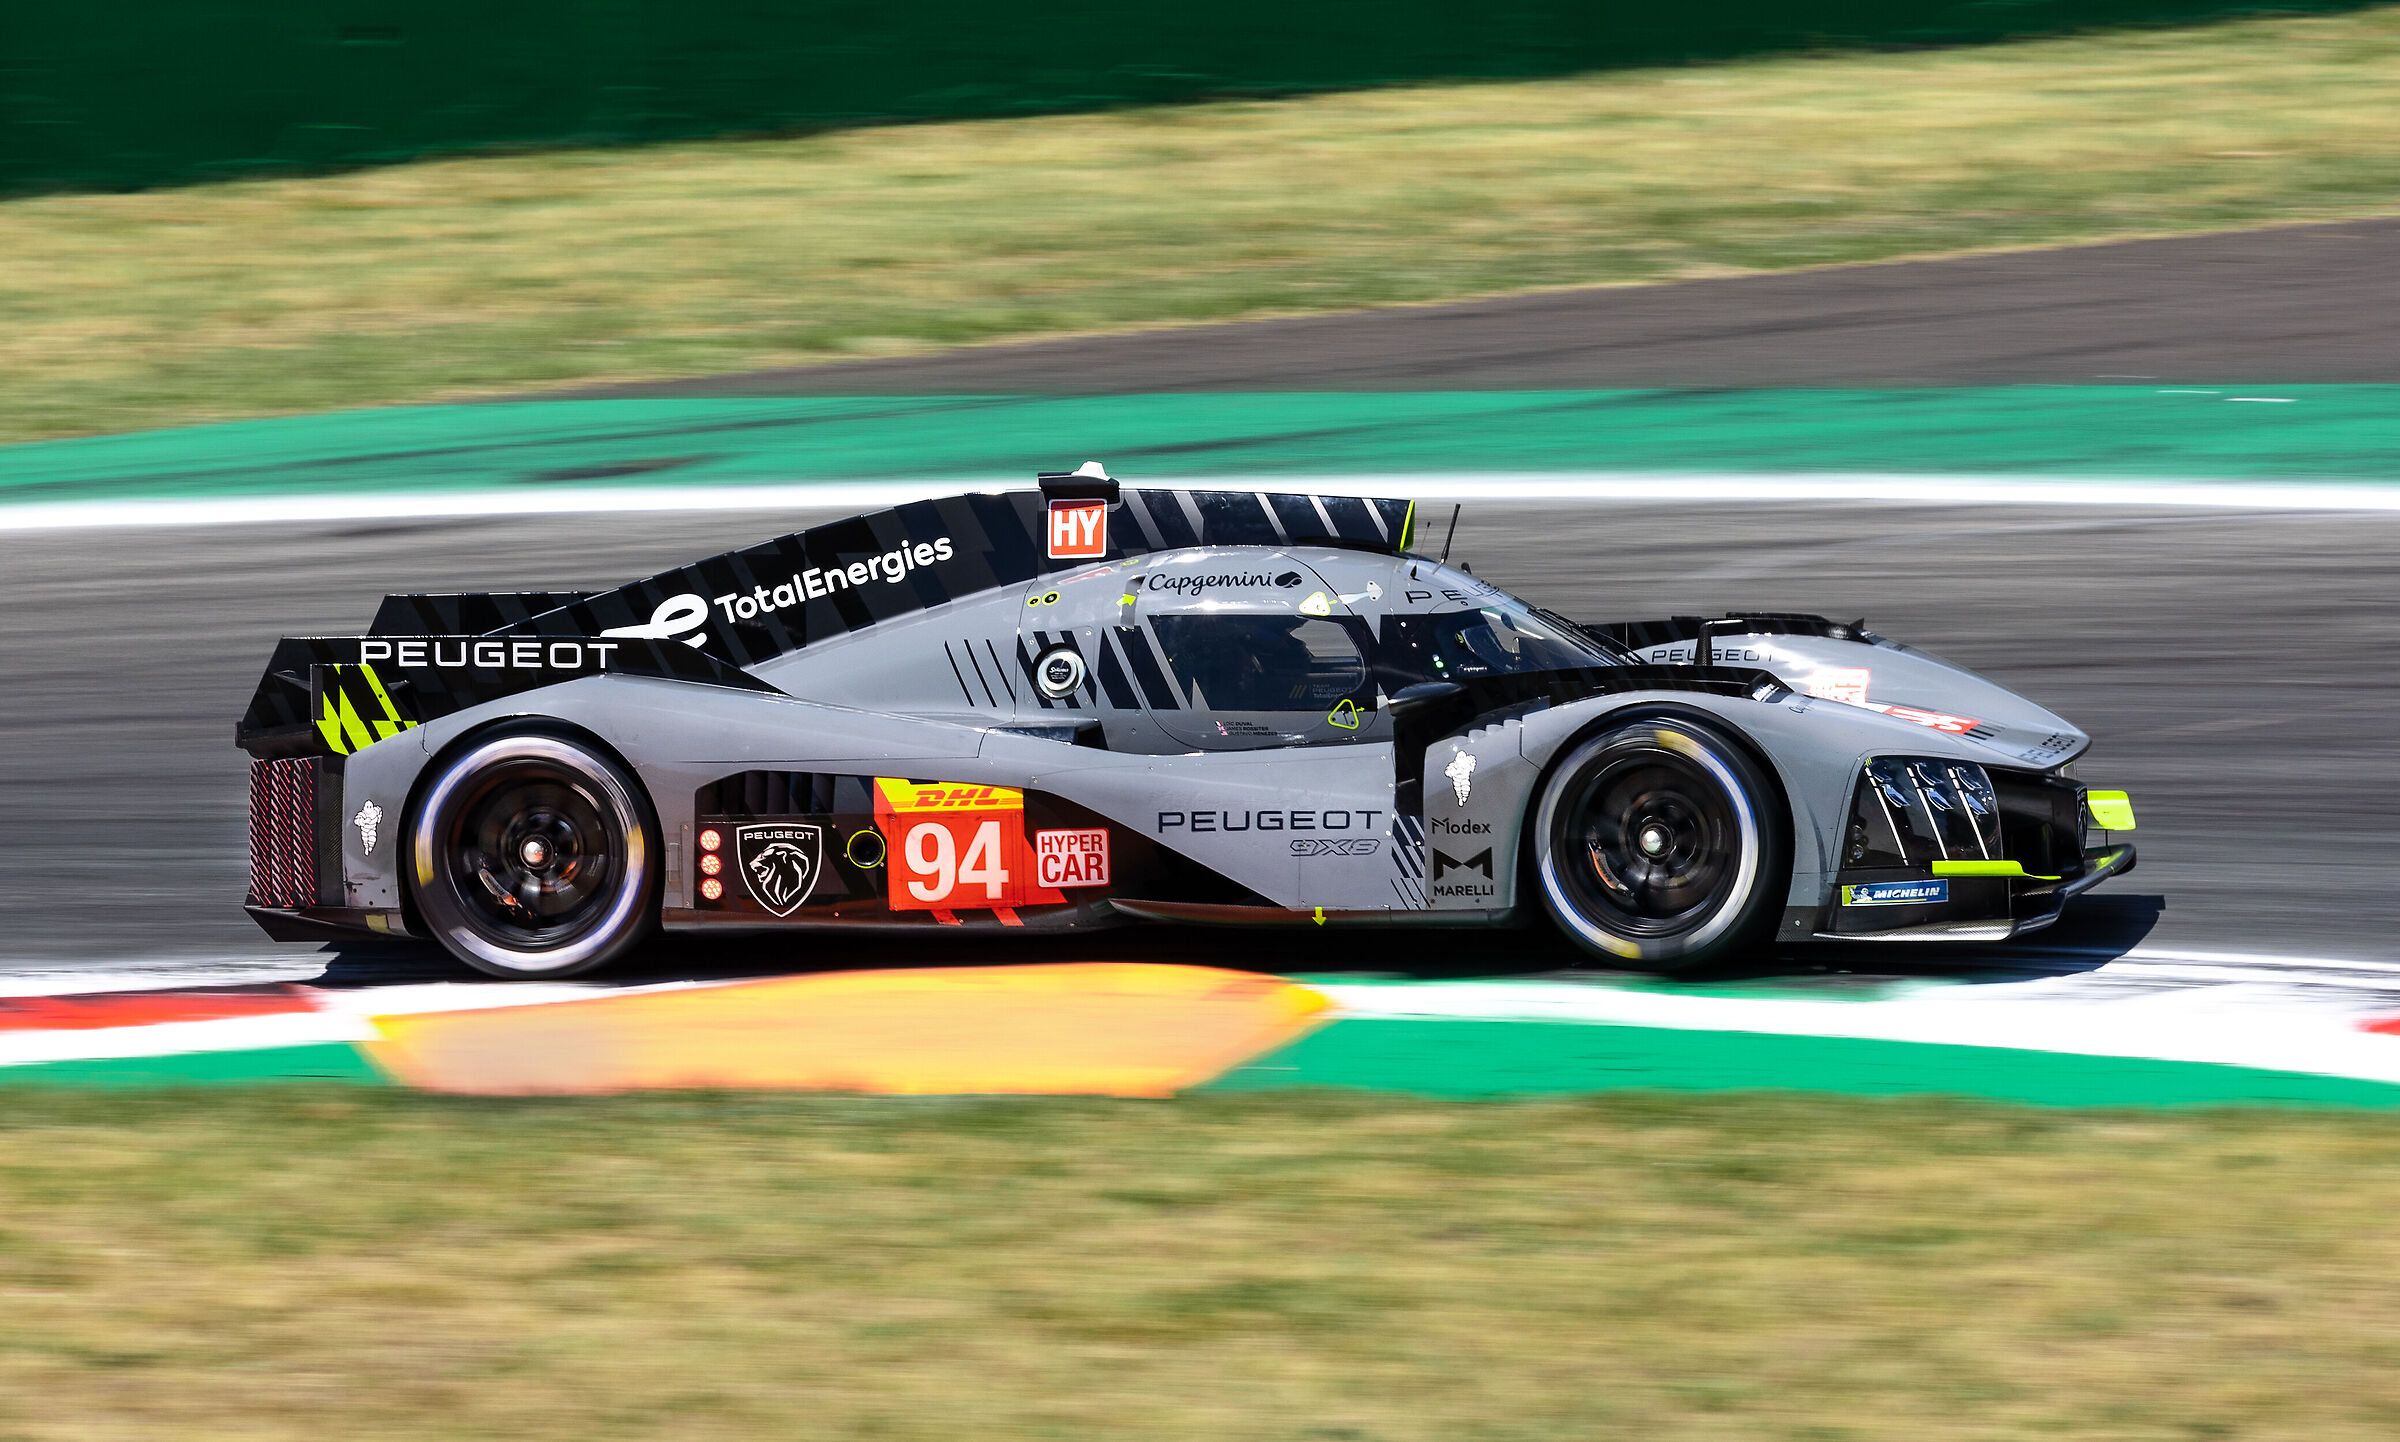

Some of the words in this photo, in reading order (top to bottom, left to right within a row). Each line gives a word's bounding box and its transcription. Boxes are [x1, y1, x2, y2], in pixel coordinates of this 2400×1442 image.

[1053, 510, 1102, 547] HY
[713, 537, 954, 624] TotalEnergies
[1149, 571, 1272, 597] Capgemini
[360, 641, 619, 669] PEUGEOT
[914, 787, 1000, 807] DHL
[1158, 810, 1383, 833] PEUGEOT
[1431, 817, 1492, 834] Modex
[743, 831, 815, 841] PEUGEOT
[1041, 834, 1104, 853] HYPER
[904, 820, 1010, 902] 94
[1042, 853, 1105, 883] CAR
[1433, 885, 1494, 896] MARELLI
[1873, 887, 1941, 899] MICHELIN
